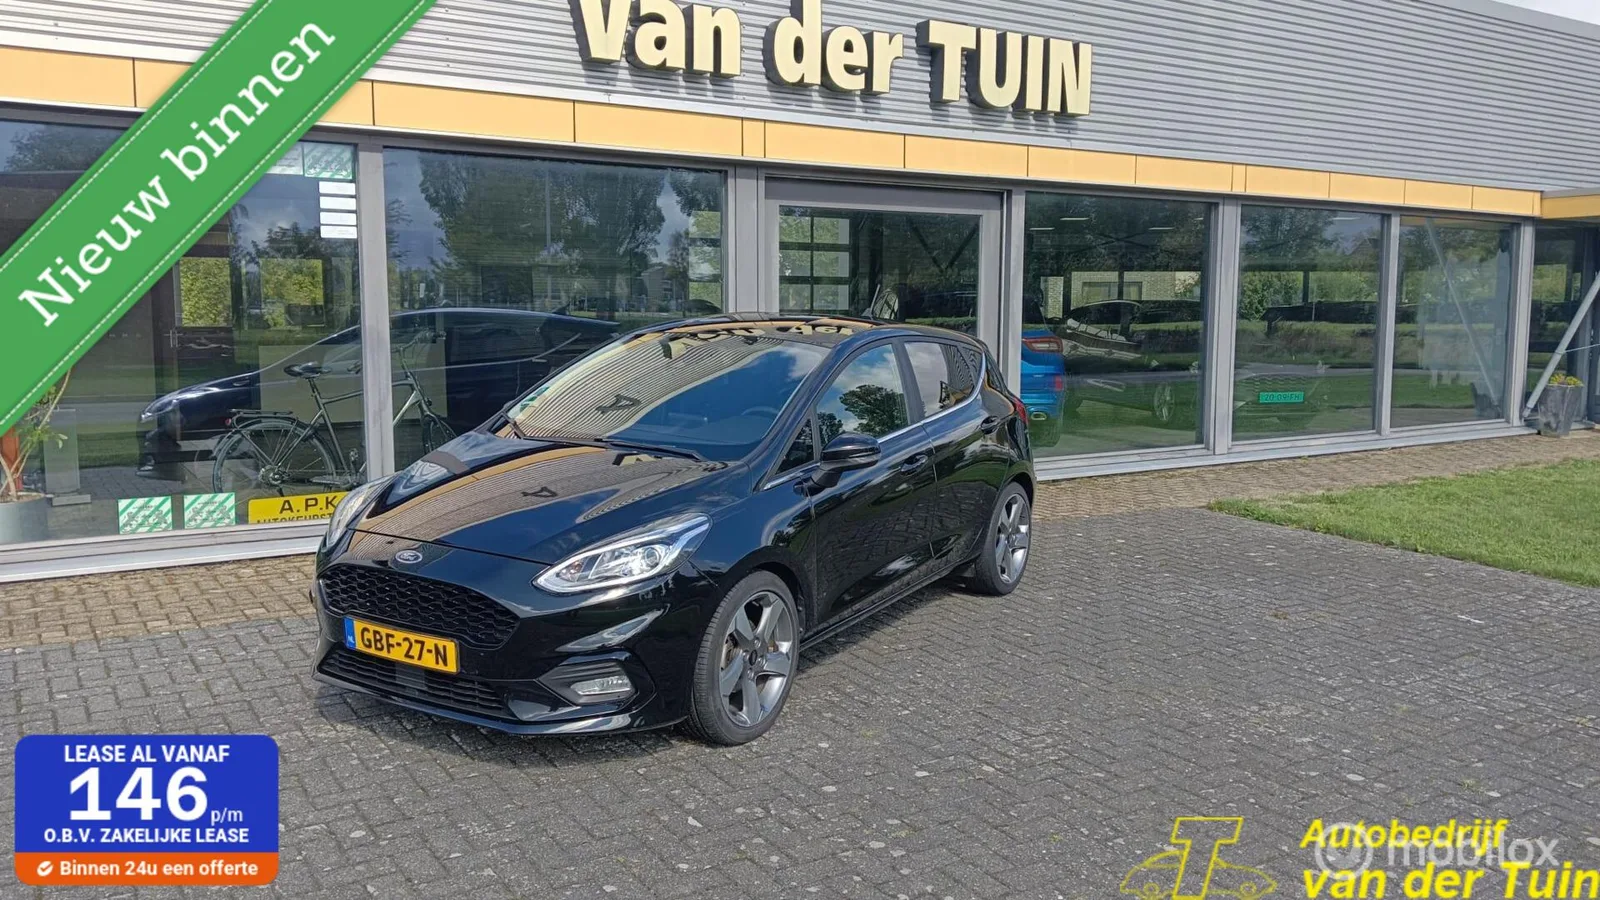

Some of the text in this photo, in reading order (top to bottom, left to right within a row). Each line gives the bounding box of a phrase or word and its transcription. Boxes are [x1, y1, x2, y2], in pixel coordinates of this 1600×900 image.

[769, 0, 904, 93] der
[922, 19, 1092, 116] TUIN
[360, 626, 448, 667] GBF-27-N
